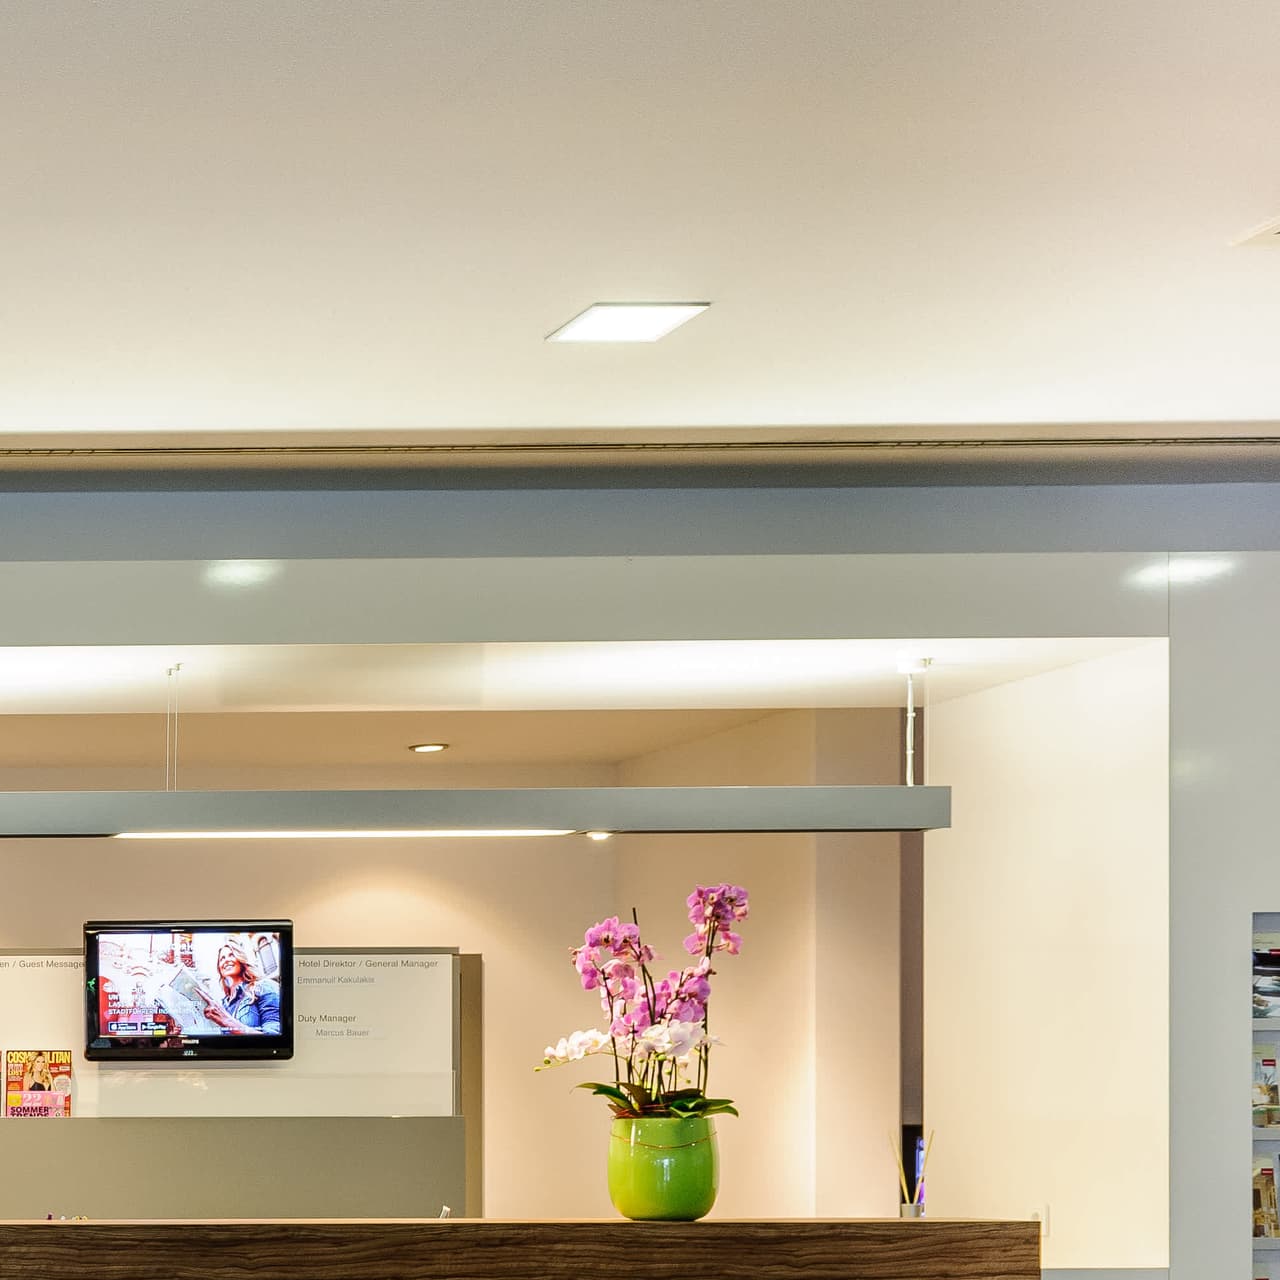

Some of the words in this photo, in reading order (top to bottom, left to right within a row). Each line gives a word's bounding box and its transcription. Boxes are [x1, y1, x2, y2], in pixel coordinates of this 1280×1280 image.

[19, 960, 44, 969] Guest
[299, 959, 321, 968] Hotel
[323, 959, 356, 968] Direktor
[365, 959, 398, 968] General
[401, 960, 438, 969] Manager
[298, 1014, 317, 1024] Duty
[319, 1014, 357, 1023] Manager
[316, 1029, 344, 1037] Marcus
[346, 1029, 370, 1037] Bauer
[7, 1051, 71, 1064] COSMLITAN
